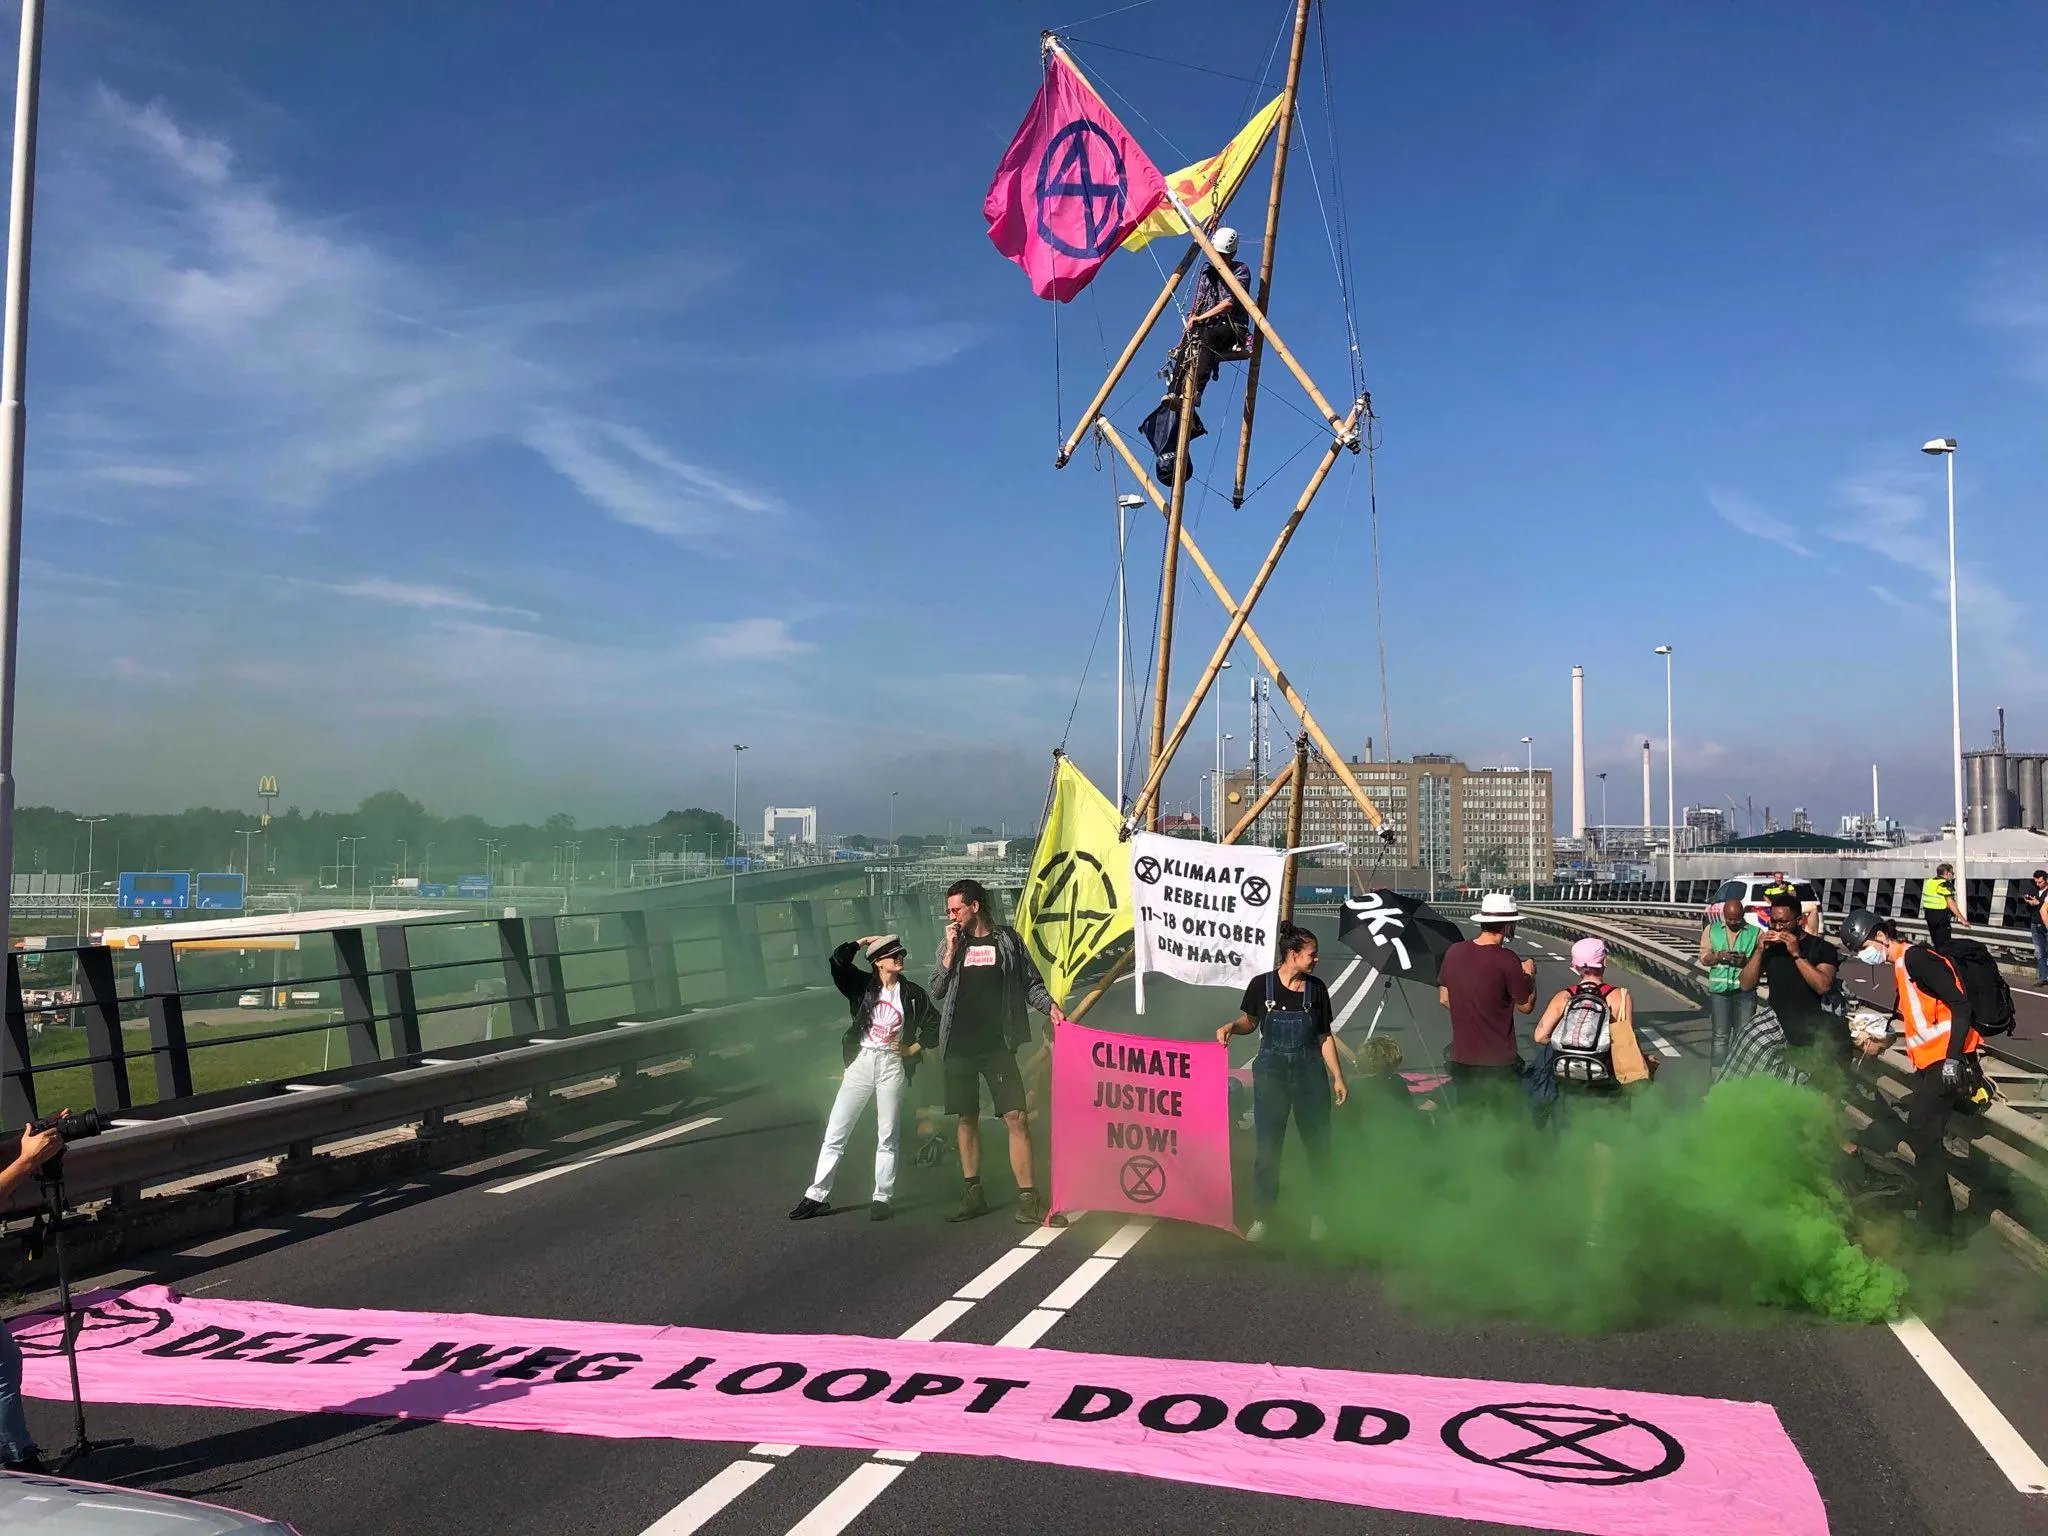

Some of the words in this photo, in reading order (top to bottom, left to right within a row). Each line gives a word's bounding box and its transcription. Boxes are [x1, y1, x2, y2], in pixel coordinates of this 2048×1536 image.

[1163, 858, 1245, 884] KLIMAAT
[1164, 885, 1237, 913] REBELLIE
[1141, 906, 1177, 930] 11-18
[1182, 917, 1266, 947] OKTOBER
[1158, 935, 1183, 957] DEN
[1187, 944, 1242, 967] HAAG
[1092, 1041, 1191, 1079] CLIMATE
[1093, 1082, 1182, 1117] JUSTICE
[1107, 1122, 1178, 1155] NOW!
[142, 1325, 402, 1364] DEZE
[402, 1342, 642, 1384] WEG
[652, 1356, 1029, 1413] LOOPT
[1052, 1384, 1411, 1446] DOOD
